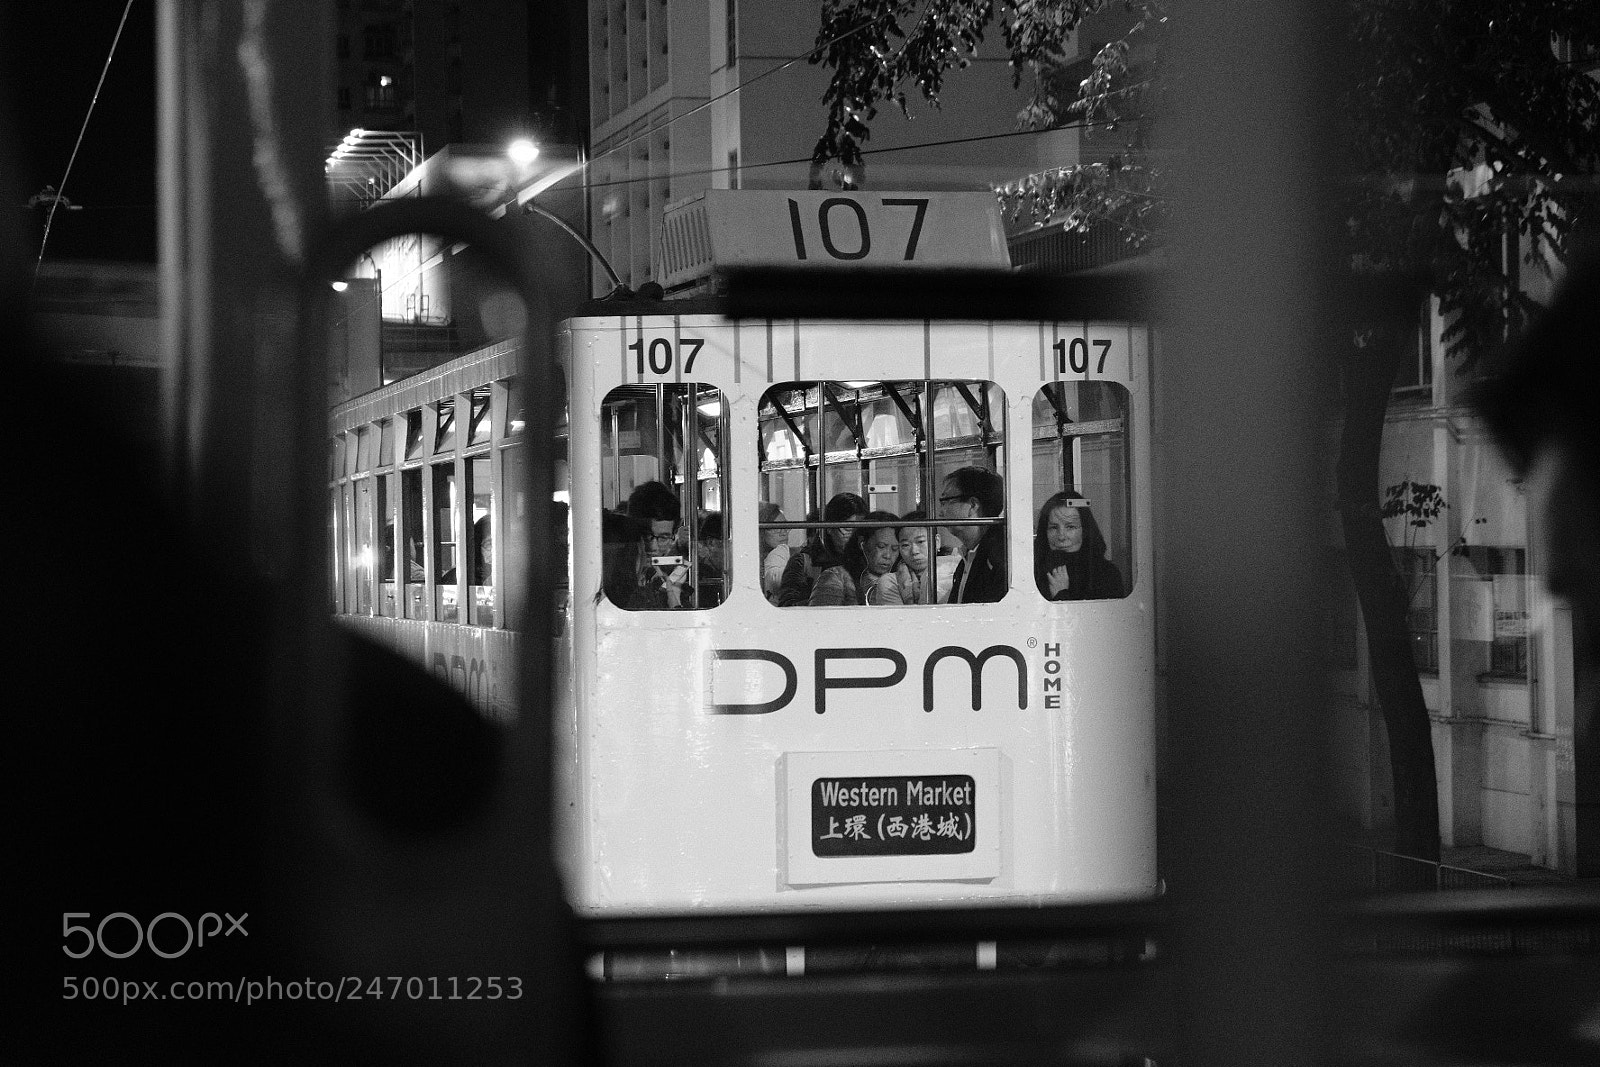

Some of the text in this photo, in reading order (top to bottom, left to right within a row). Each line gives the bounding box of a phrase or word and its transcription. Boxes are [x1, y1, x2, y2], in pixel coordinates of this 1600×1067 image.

[787, 197, 930, 261] 107
[628, 337, 705, 375] 107
[1052, 338, 1112, 374] 107
[1043, 642, 1062, 710] HOME
[820, 780, 972, 807] Western Market
